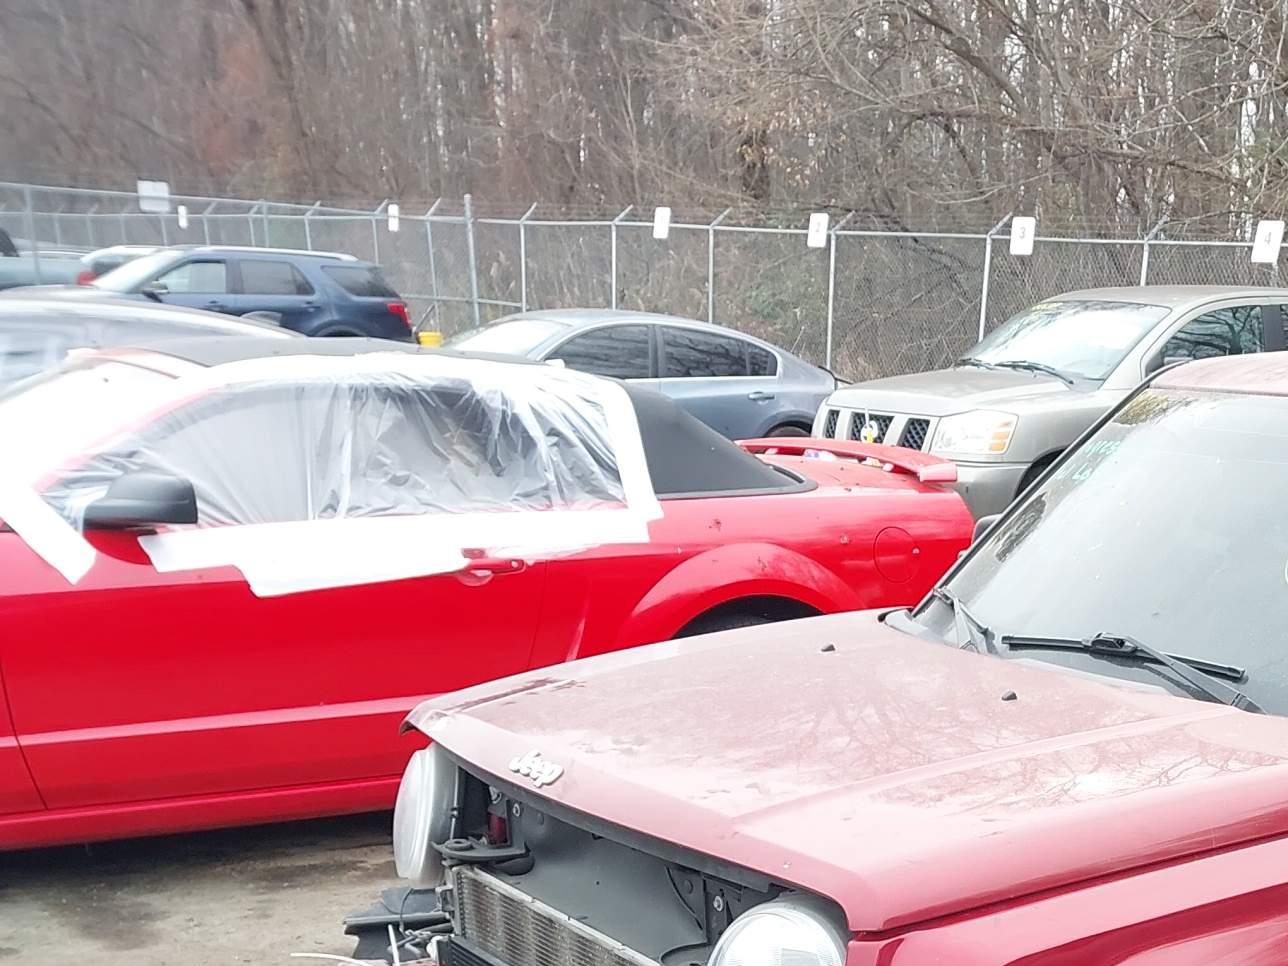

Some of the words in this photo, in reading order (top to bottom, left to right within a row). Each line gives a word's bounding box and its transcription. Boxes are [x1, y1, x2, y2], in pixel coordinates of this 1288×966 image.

[1019, 226, 1026, 239] 3
[1264, 231, 1272, 245] 4
[508, 749, 565, 788] Jeep
